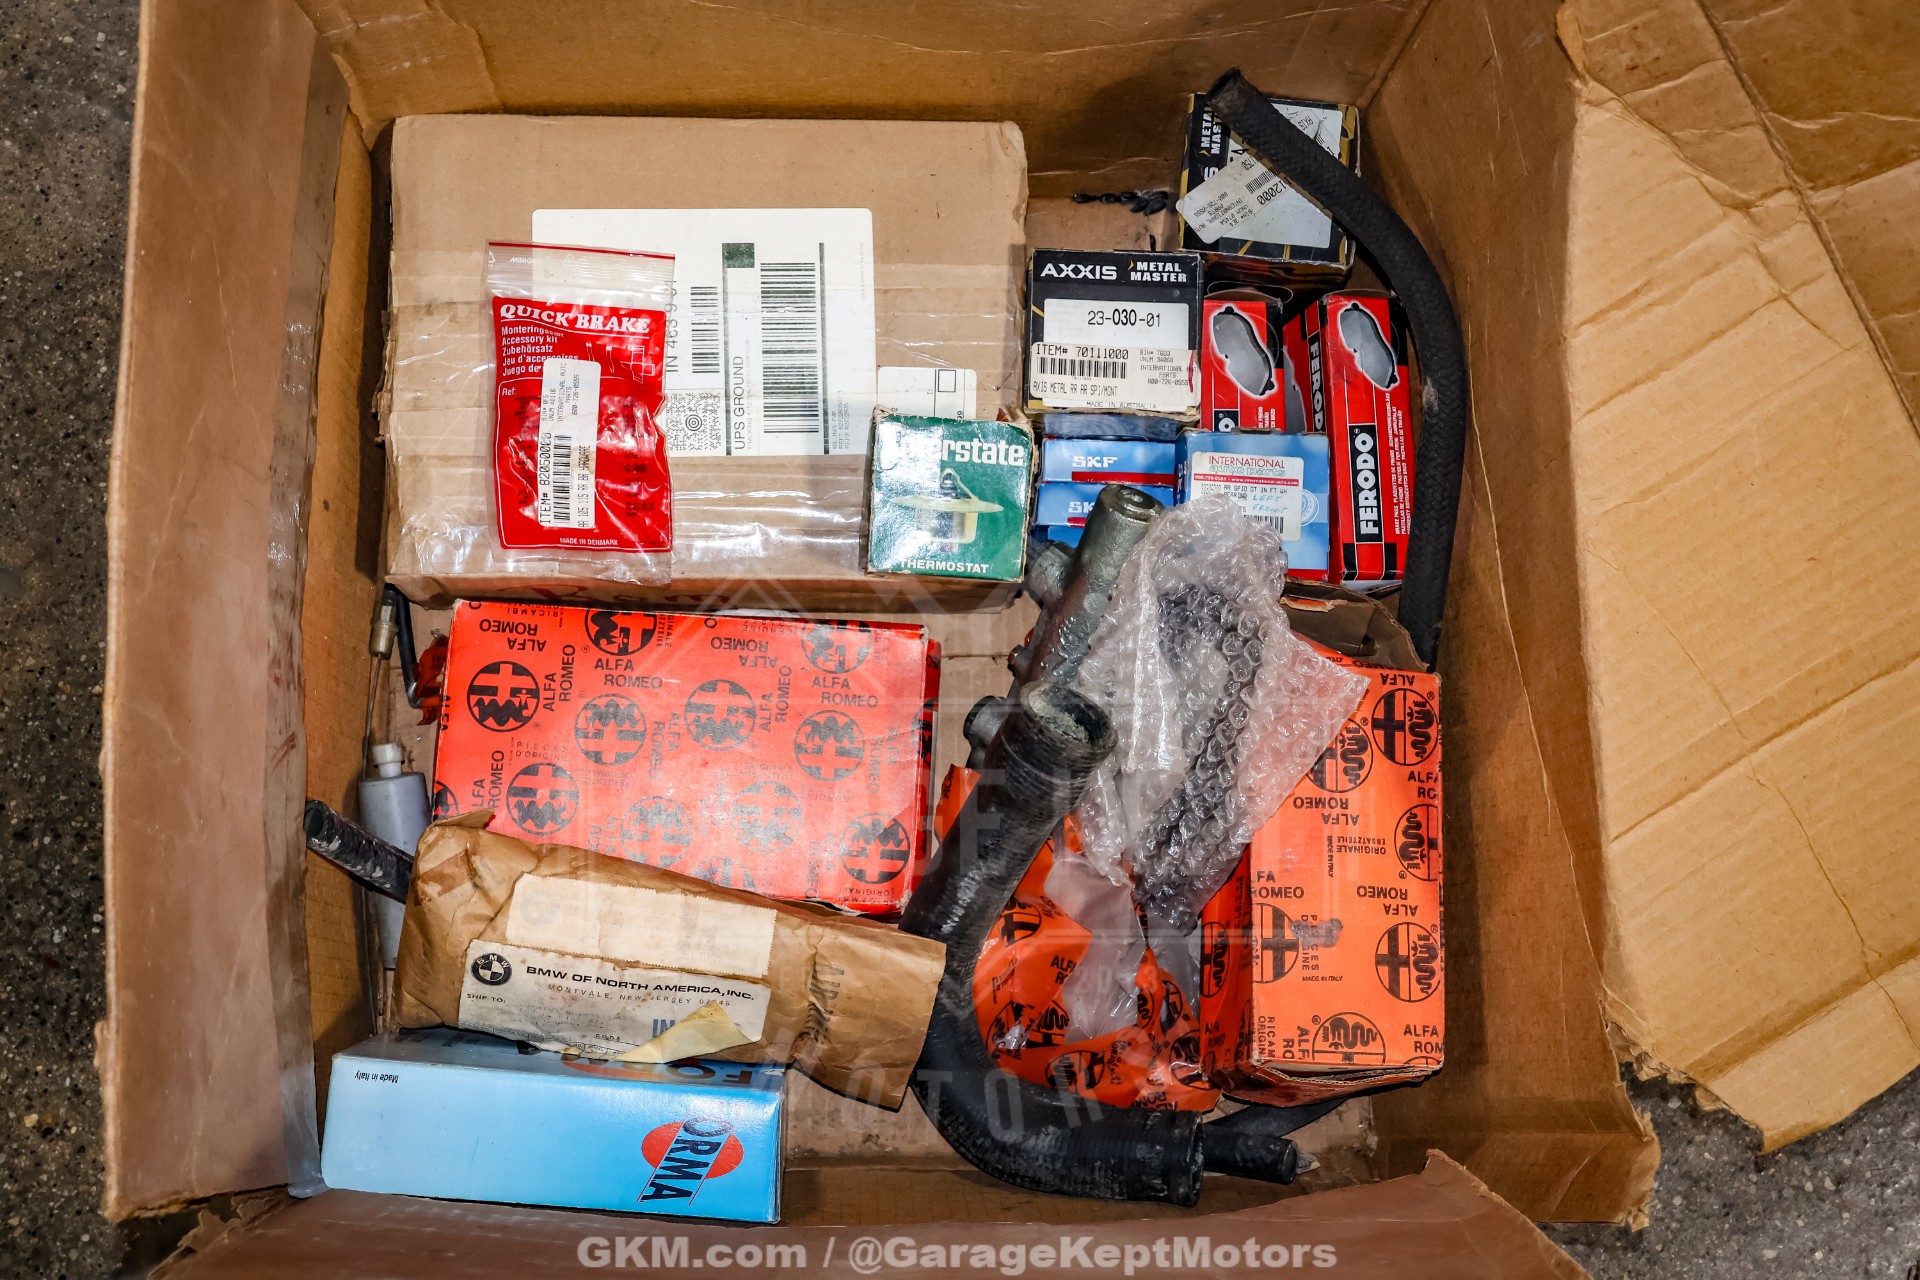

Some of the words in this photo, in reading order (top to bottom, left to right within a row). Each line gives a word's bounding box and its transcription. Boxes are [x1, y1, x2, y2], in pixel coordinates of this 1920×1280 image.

[1207, 197, 1244, 224] INTERNATIONAL
[1208, 204, 1225, 217] PARTS
[1040, 263, 1117, 281] AXXIS
[1136, 262, 1182, 272] METAL
[1130, 272, 1187, 283] MASTER
[500, 304, 570, 326] QUICK
[575, 314, 650, 334] BRAKE
[1087, 309, 1161, 328] 23-030-01
[502, 334, 545, 345] Accessory
[546, 335, 558, 344] kit
[502, 344, 554, 356] Zubehörsatz
[1036, 343, 1068, 355] ITEM#
[1075, 347, 1129, 360] 70111000
[502, 355, 516, 366] Jeu
[502, 364, 526, 377] Juego
[733, 356, 746, 418] GROUND
[1032, 380, 1048, 393] AXIS
[1049, 382, 1067, 394] METAL
[1309, 341, 1324, 433] FEROD
[557, 377, 566, 422] INTERNATIONAL
[734, 423, 746, 450] UPS
[539, 432, 552, 486] 82050000
[1072, 456, 1118, 468] SKF
[1208, 455, 1286, 469] INTERNATIONAL
[1209, 464, 1245, 477] auto
[1246, 466, 1286, 477] parts
[1354, 432, 1379, 536] FERODO
[540, 492, 551, 524] ITEM#
[1068, 501, 1096, 514] SK
[1252, 503, 1289, 514] FRONT
[559, 537, 579, 545] MADE
[587, 538, 618, 546] DENMARK
[900, 560, 989, 574] THERMOSTAT
[506, 606, 559, 617] RICAMBI
[479, 618, 538, 636] ROMEO
[506, 637, 547, 652] ALFA
[710, 636, 769, 654] ROMEO
[594, 657, 634, 672] ALFA
[738, 654, 778, 669] ALFA
[559, 644, 576, 702] ROMEO
[603, 672, 663, 689] ROMEO
[1379, 672, 1416, 686] ALFA
[811, 675, 851, 690] ALFA
[543, 672, 557, 712] ALFA
[775, 665, 792, 723] ROMEO
[821, 691, 879, 708] ROMEO
[759, 692, 773, 733] ALFA
[487, 750, 505, 810] ROMEO
[471, 778, 486, 808] LFA
[1292, 797, 1349, 810] ROMEO
[1321, 812, 1360, 826] ALFA
[1336, 836, 1386, 845] ERSATZTEILE
[1336, 844, 1387, 855] ORIGINALE
[1356, 885, 1408, 900] ROMEO
[1382, 903, 1419, 917] ALFA
[1050, 955, 1076, 974] ALF
[526, 966, 568, 979] BMW
[571, 973, 592, 984] OF
[596, 976, 650, 992] NORTH
[466, 993, 488, 1001] SHIP
[547, 984, 614, 1000] MONTVALE,
[619, 993, 642, 1001] NEW
[650, 995, 691, 1004] JERSEY
[1403, 1023, 1439, 1038] ALFA
[1297, 1025, 1311, 1060] ALF
[1414, 1040, 1443, 1055] ROM
[353, 1071, 370, 1082] Italy
[371, 1073, 380, 1082] in
[381, 1074, 400, 1083] Made
[639, 1116, 734, 1203] ORMA
